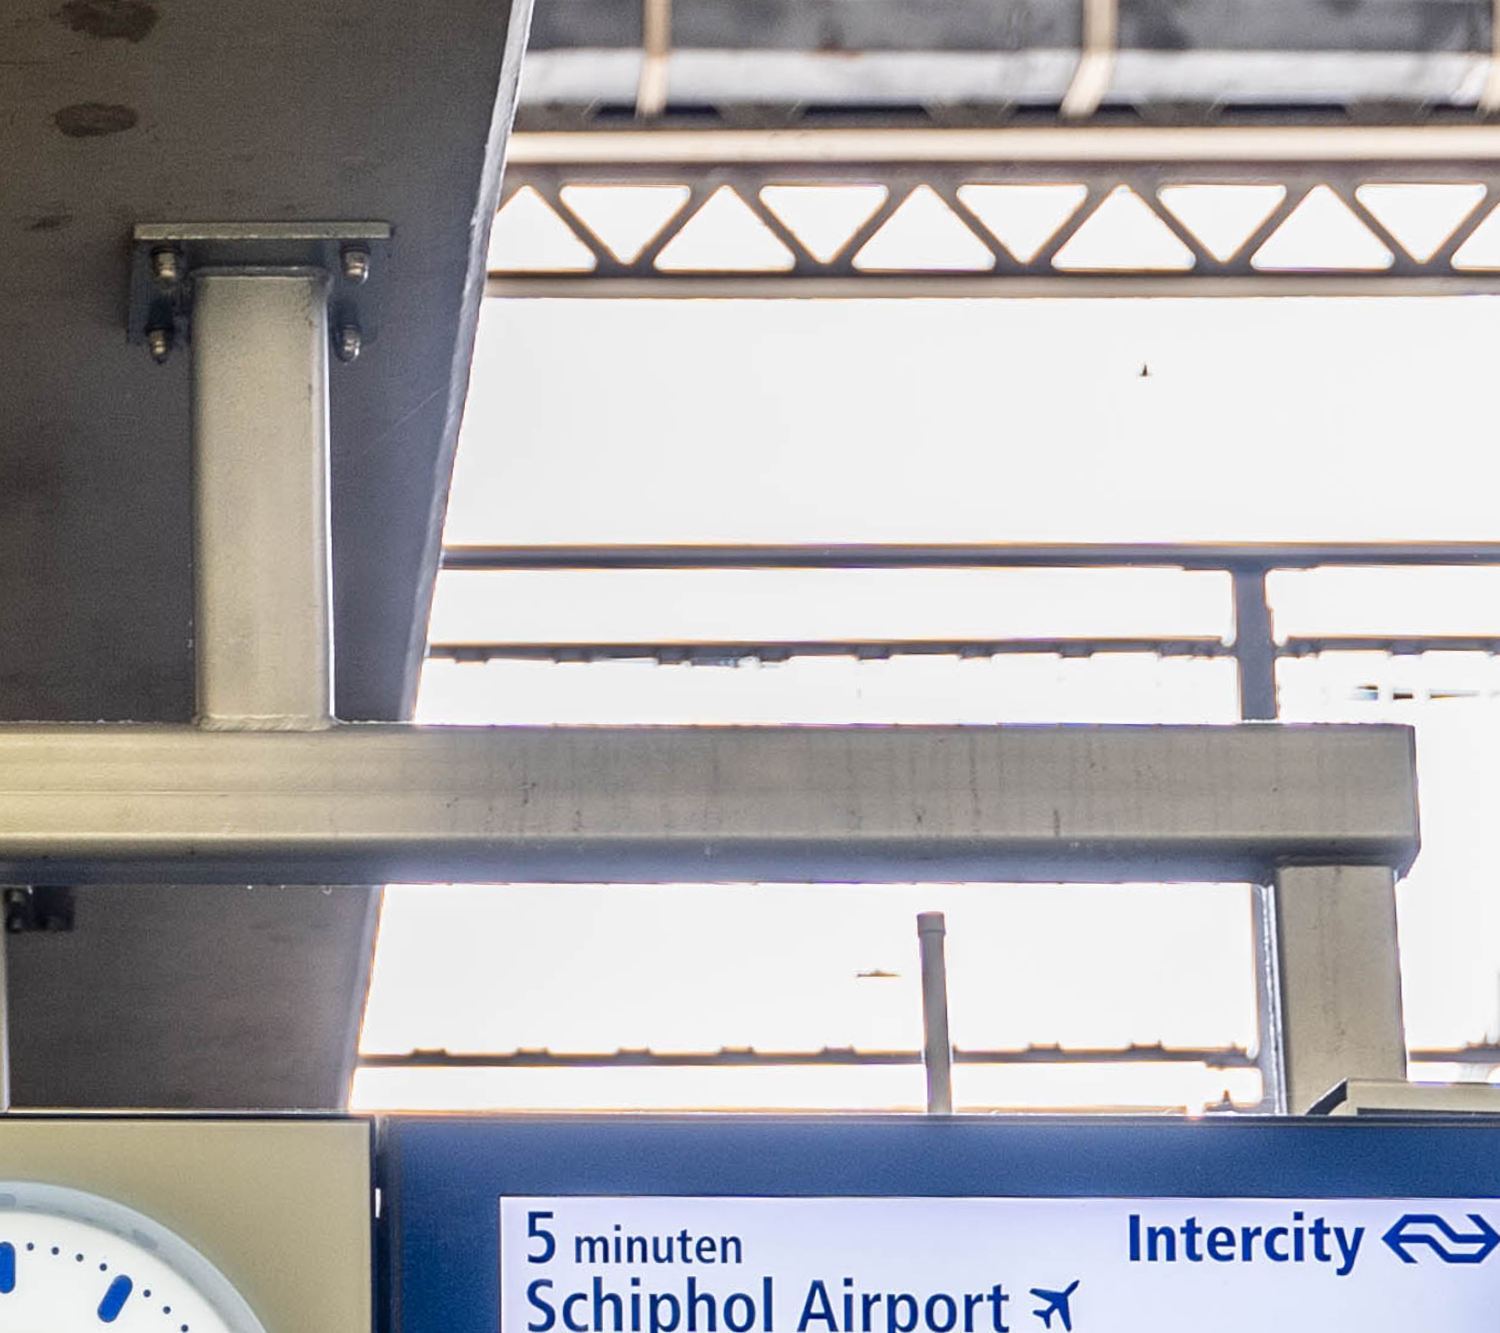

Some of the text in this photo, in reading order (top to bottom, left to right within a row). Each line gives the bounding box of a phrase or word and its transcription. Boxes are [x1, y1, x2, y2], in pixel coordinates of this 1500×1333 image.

[526, 1211, 743, 1264] 5 minuten
[1128, 1211, 1365, 1276] Intercity
